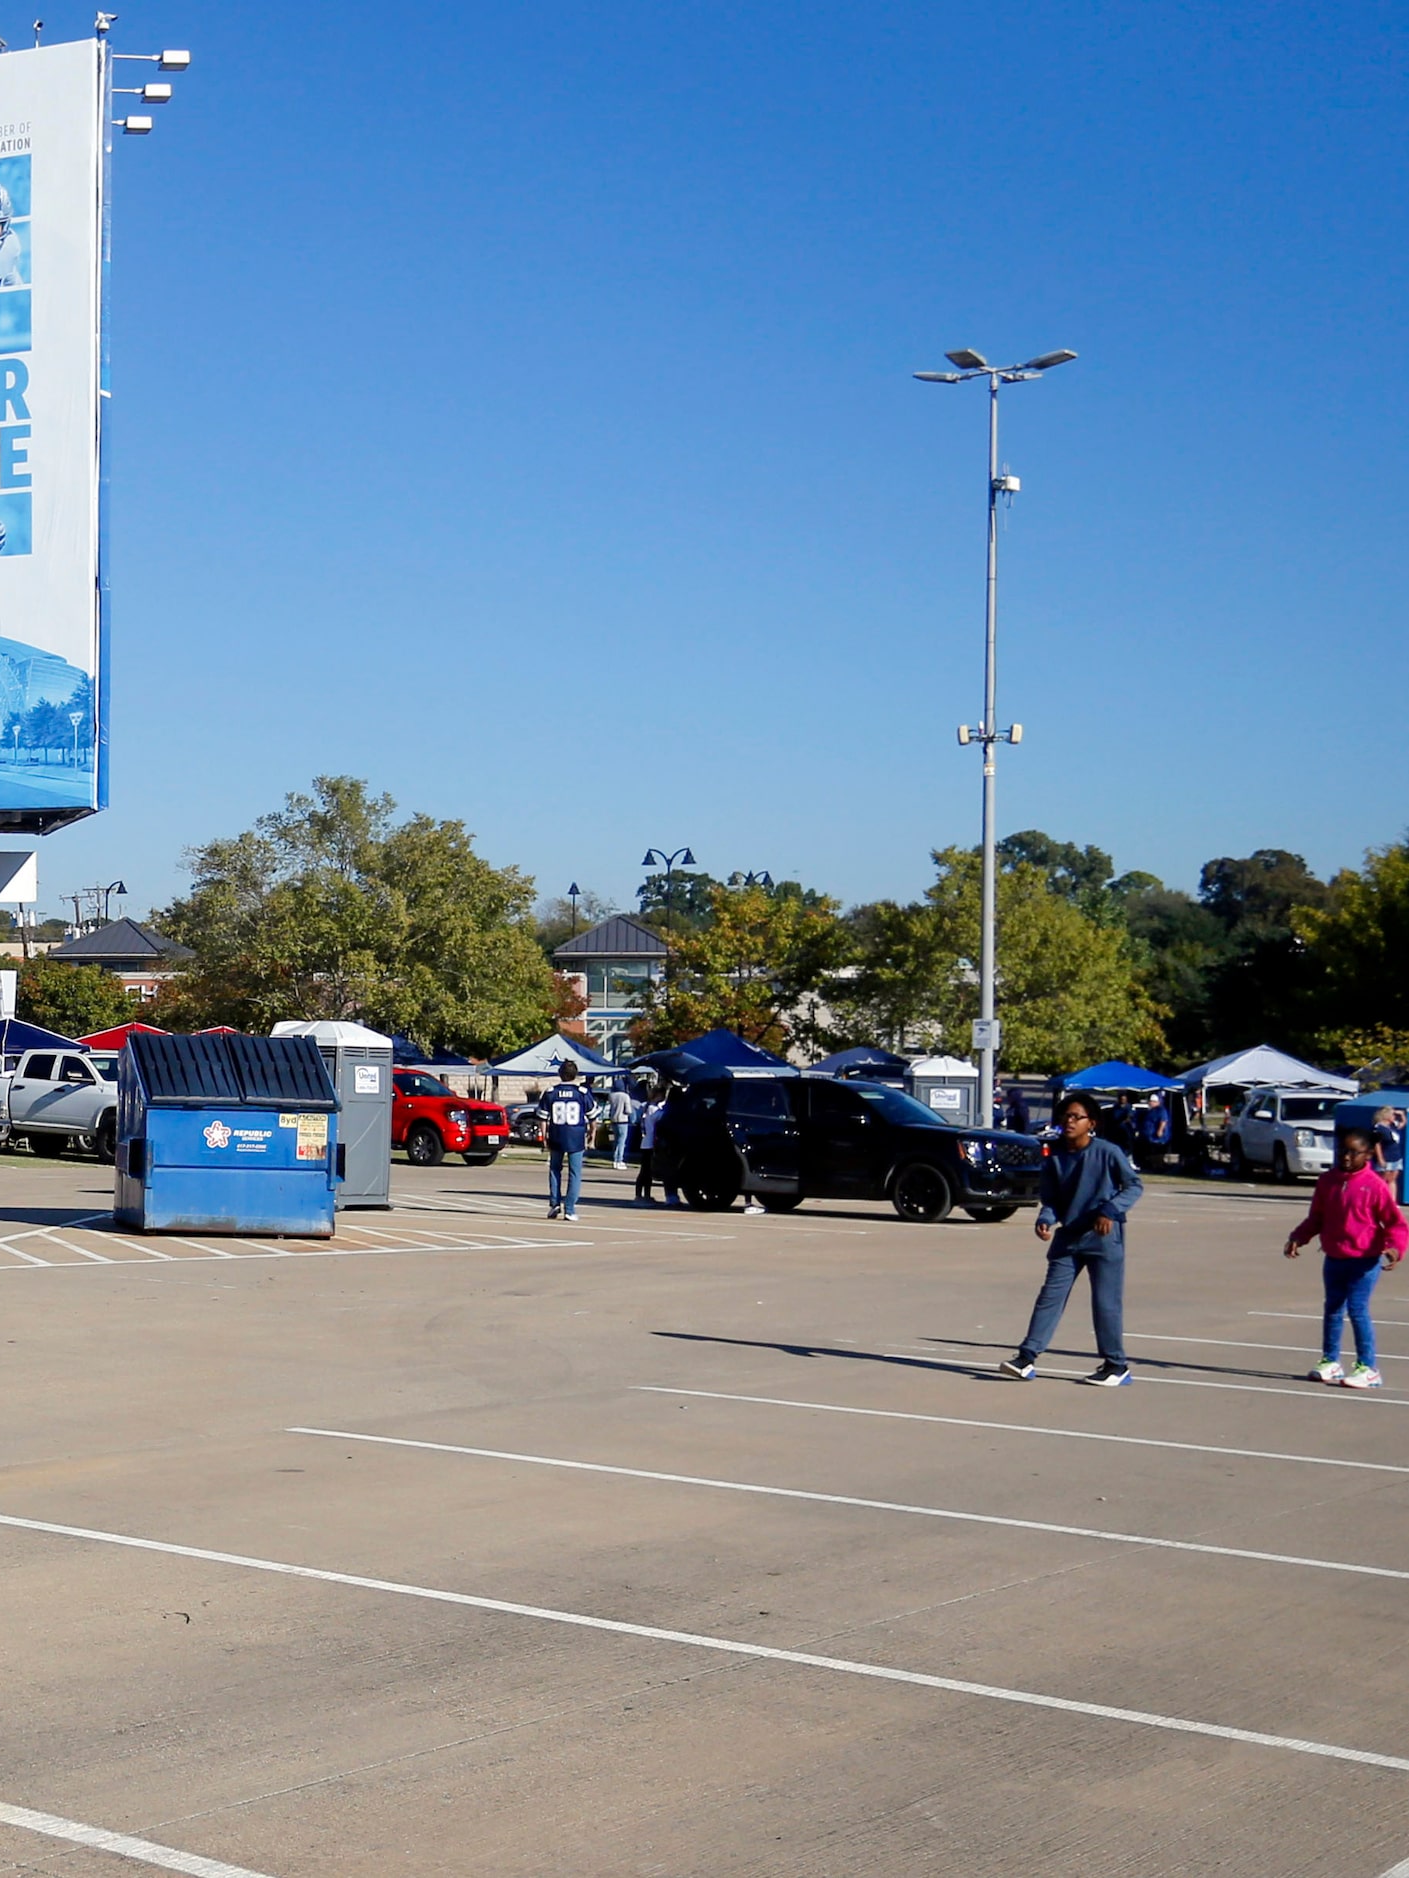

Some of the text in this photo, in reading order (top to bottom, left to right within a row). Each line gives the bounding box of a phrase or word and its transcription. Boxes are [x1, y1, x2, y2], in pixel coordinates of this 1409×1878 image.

[19, 121, 31, 134] OF
[552, 1101, 581, 1125] 88
[233, 1129, 273, 1138] REPUBLIC
